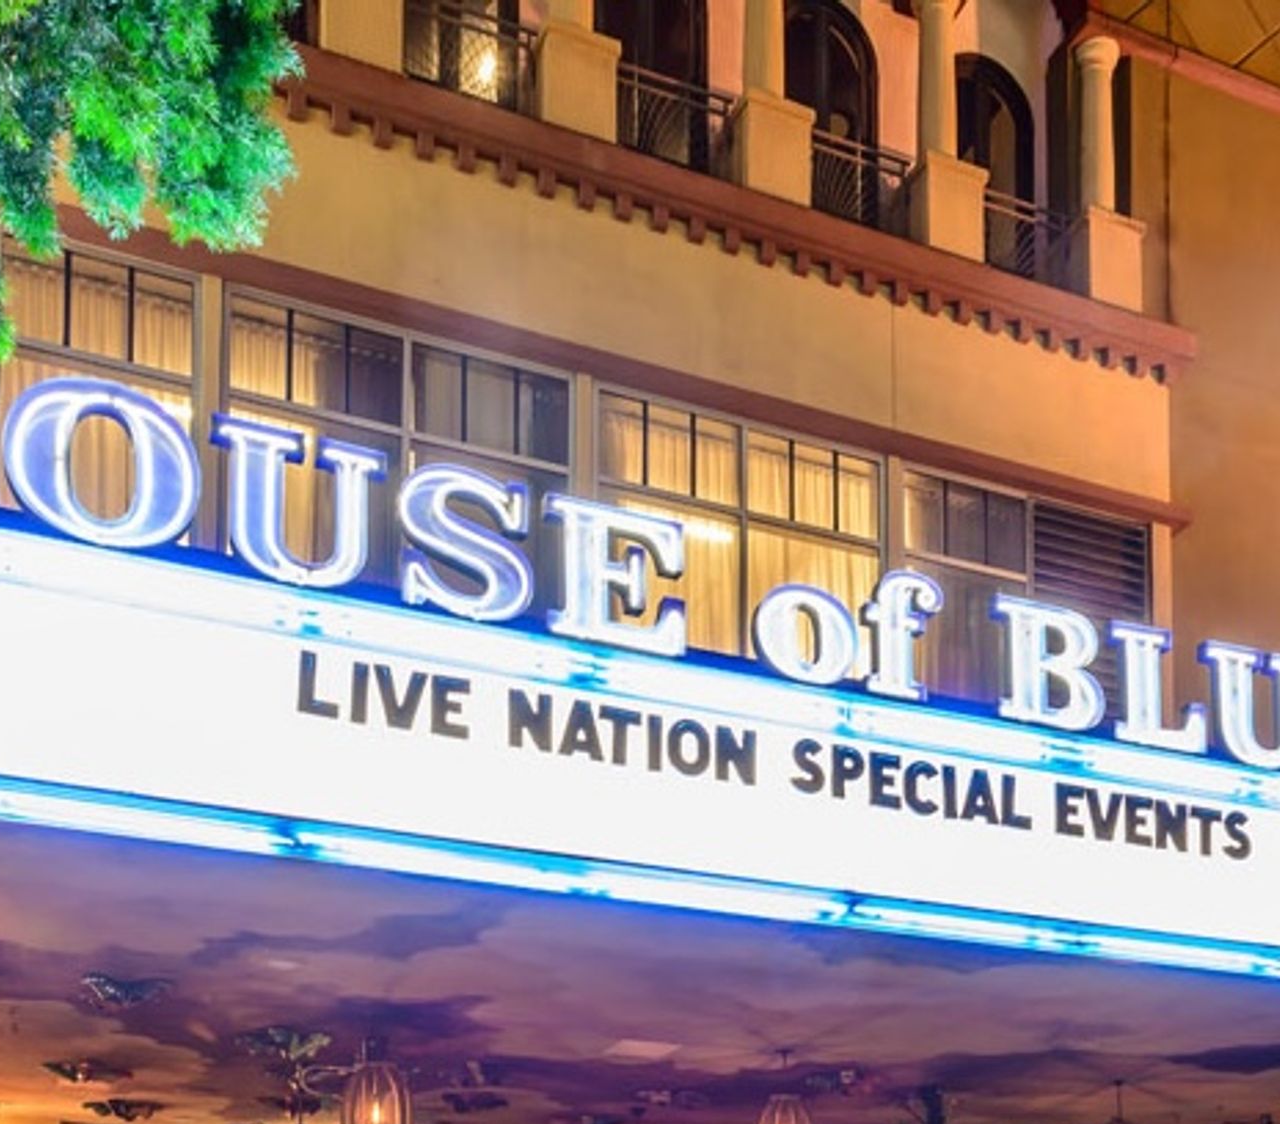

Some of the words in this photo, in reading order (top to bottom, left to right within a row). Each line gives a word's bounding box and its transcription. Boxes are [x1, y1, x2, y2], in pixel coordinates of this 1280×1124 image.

[750, 565, 944, 701] of
[297, 650, 471, 740] LIVE
[507, 688, 757, 786] NATION
[789, 738, 1032, 831] SPECIAL
[1054, 782, 1252, 861] EVENTS
